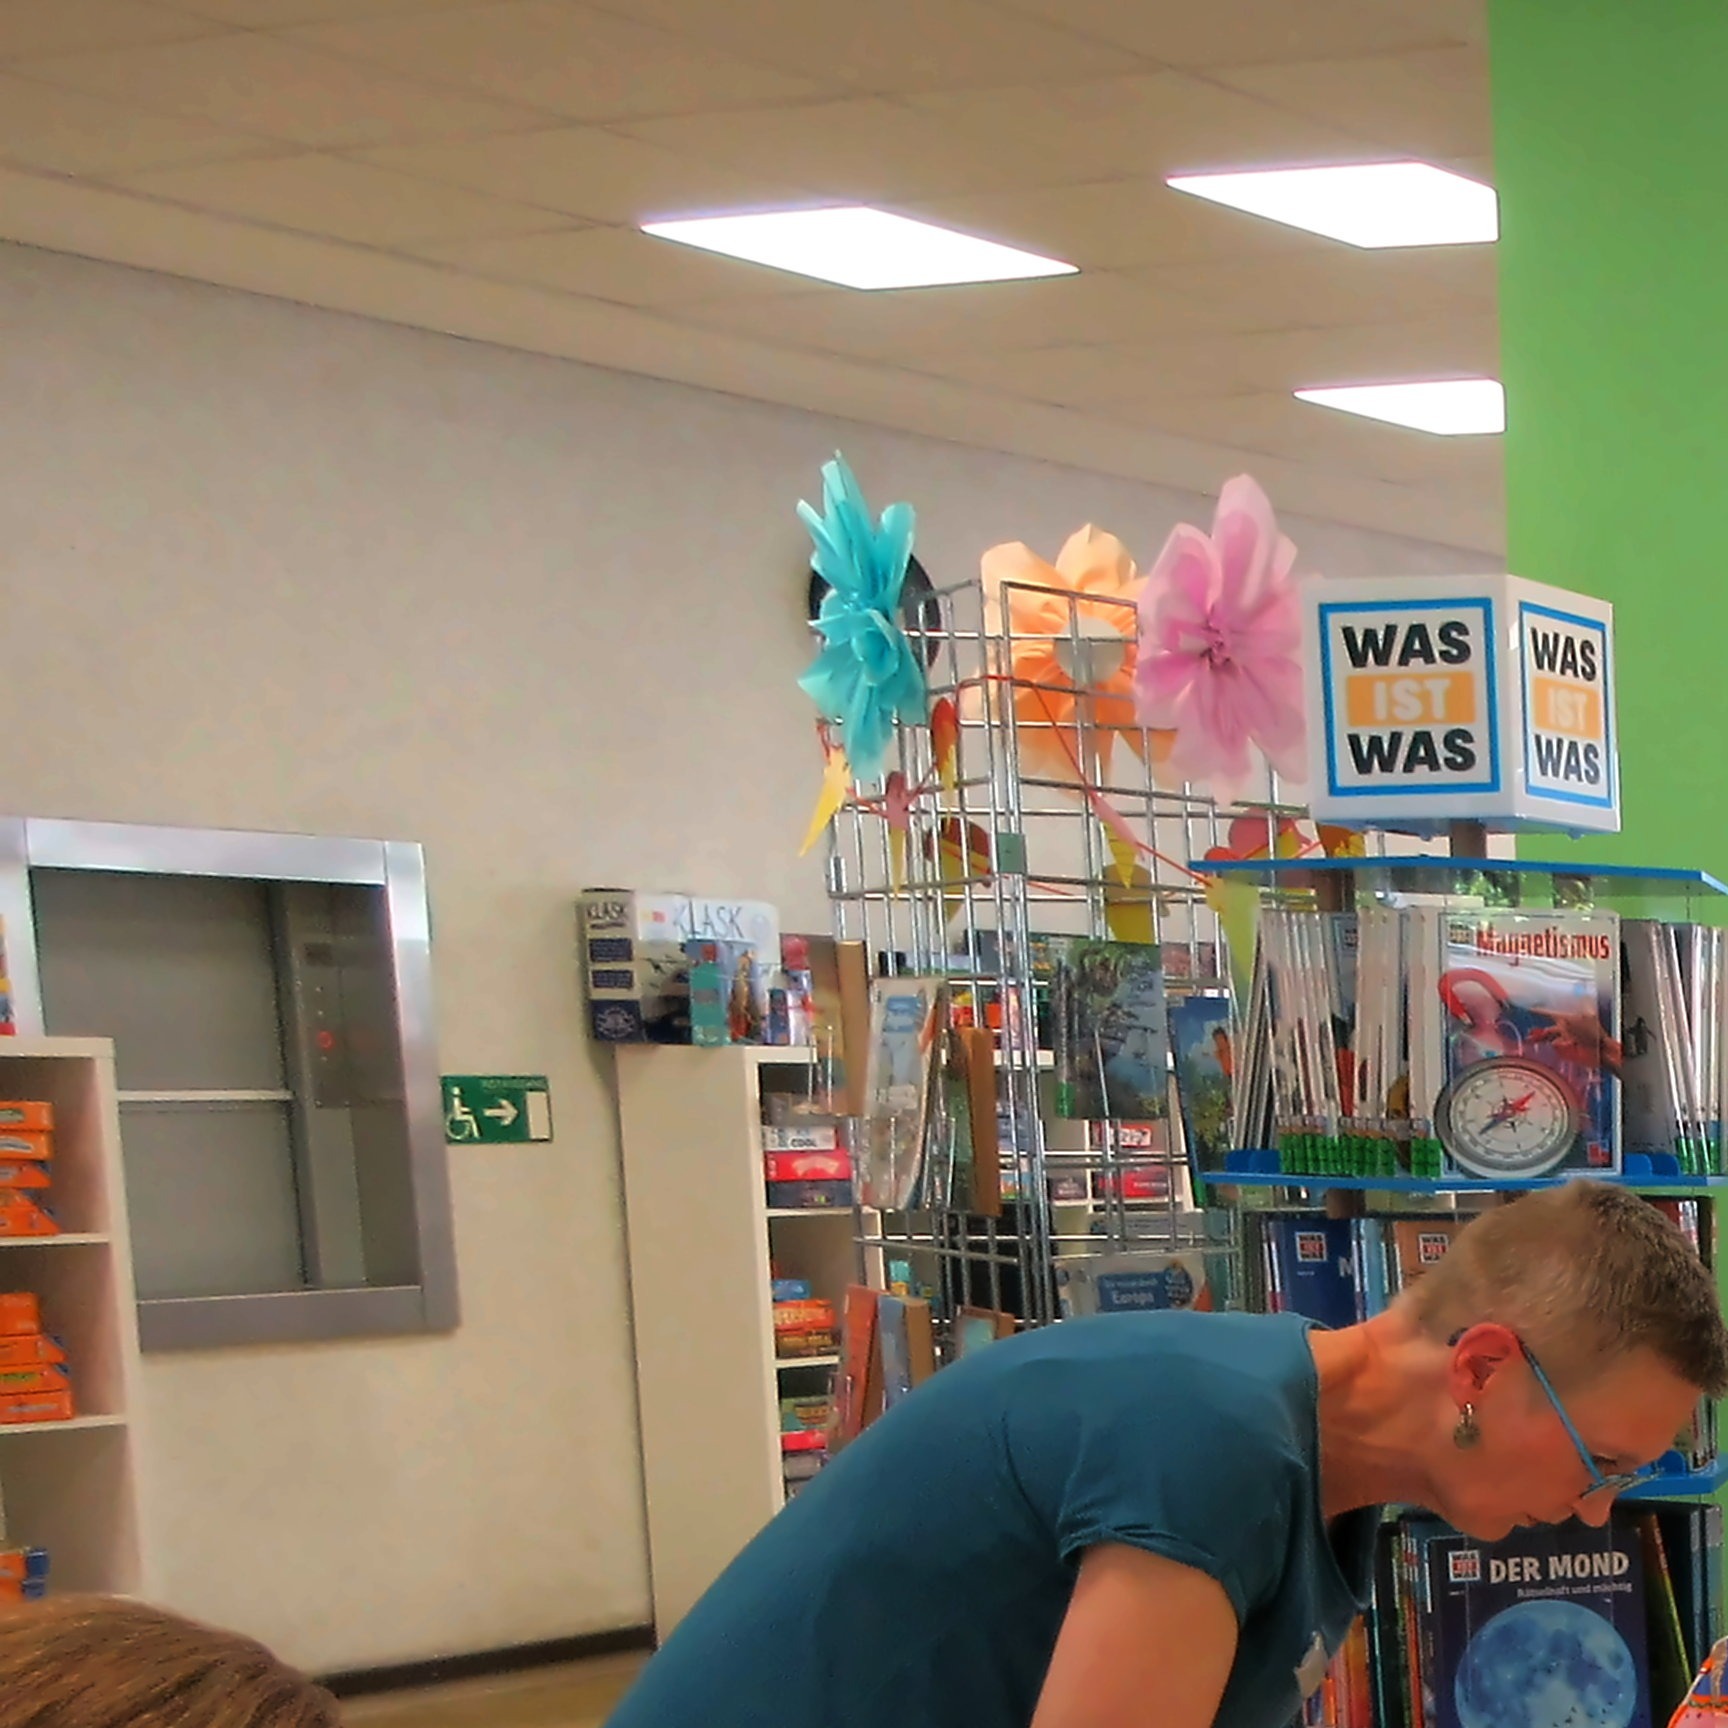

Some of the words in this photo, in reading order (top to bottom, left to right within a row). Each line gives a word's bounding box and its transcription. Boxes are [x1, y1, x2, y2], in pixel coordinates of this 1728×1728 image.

[1342, 621, 1472, 667] WAS
[1531, 627, 1597, 682] WAS
[1373, 679, 1450, 719] IST
[1547, 692, 1586, 729] IST
[1349, 730, 1476, 774] WAS
[1534, 735, 1600, 784] WAS
[674, 899, 743, 939] KLASK
[1476, 922, 1609, 966] Magnetismus
[1489, 1557, 1541, 1584] DER
[1549, 1552, 1629, 1580] MOND
